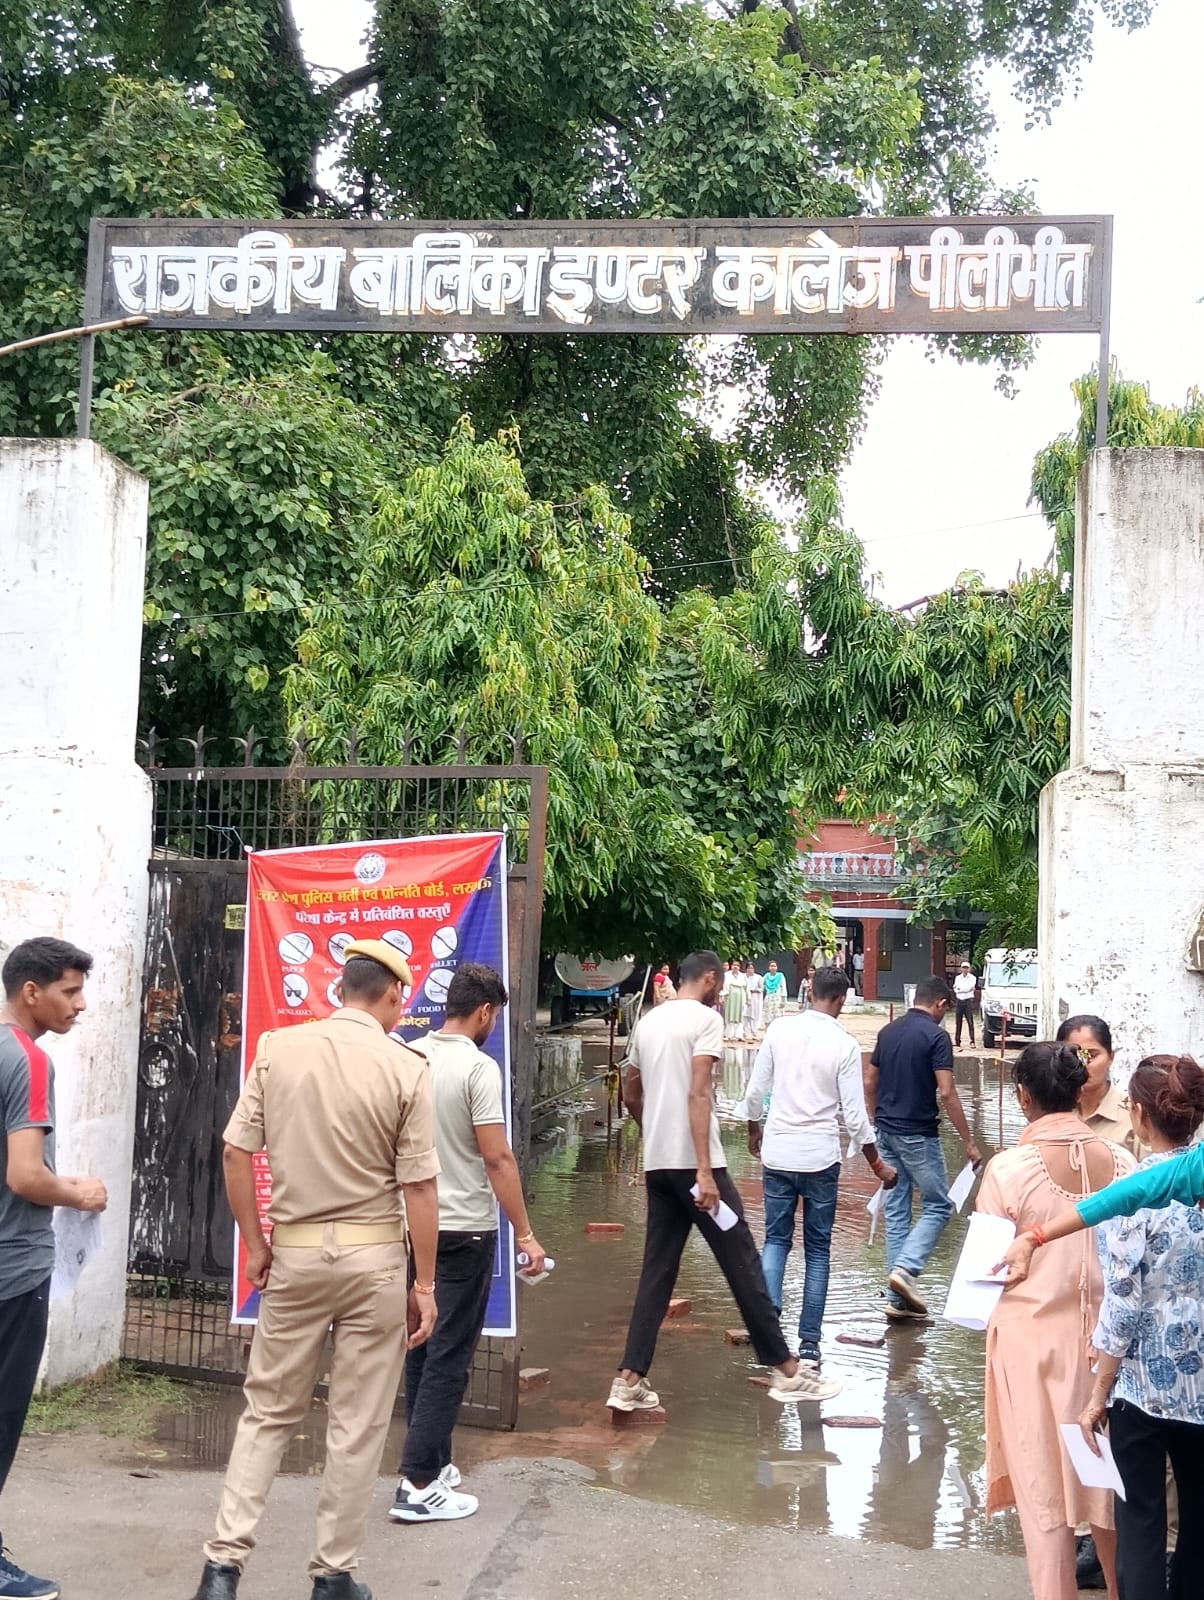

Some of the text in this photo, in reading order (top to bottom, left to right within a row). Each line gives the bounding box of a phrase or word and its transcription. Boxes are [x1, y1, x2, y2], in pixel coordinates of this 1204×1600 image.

[111, 226, 1095, 325] राजकीय बालिका इण्टर कालेज पीलीभीत
[301, 889, 333, 908] पुलिस
[337, 887, 360, 903] भर्ती
[362, 886, 378, 901] एवं
[382, 883, 420, 900] प्रोन्नति
[322, 908, 347, 925] केन्द्र
[349, 907, 360, 922] में
[362, 905, 414, 922] प्रतिबंधित
